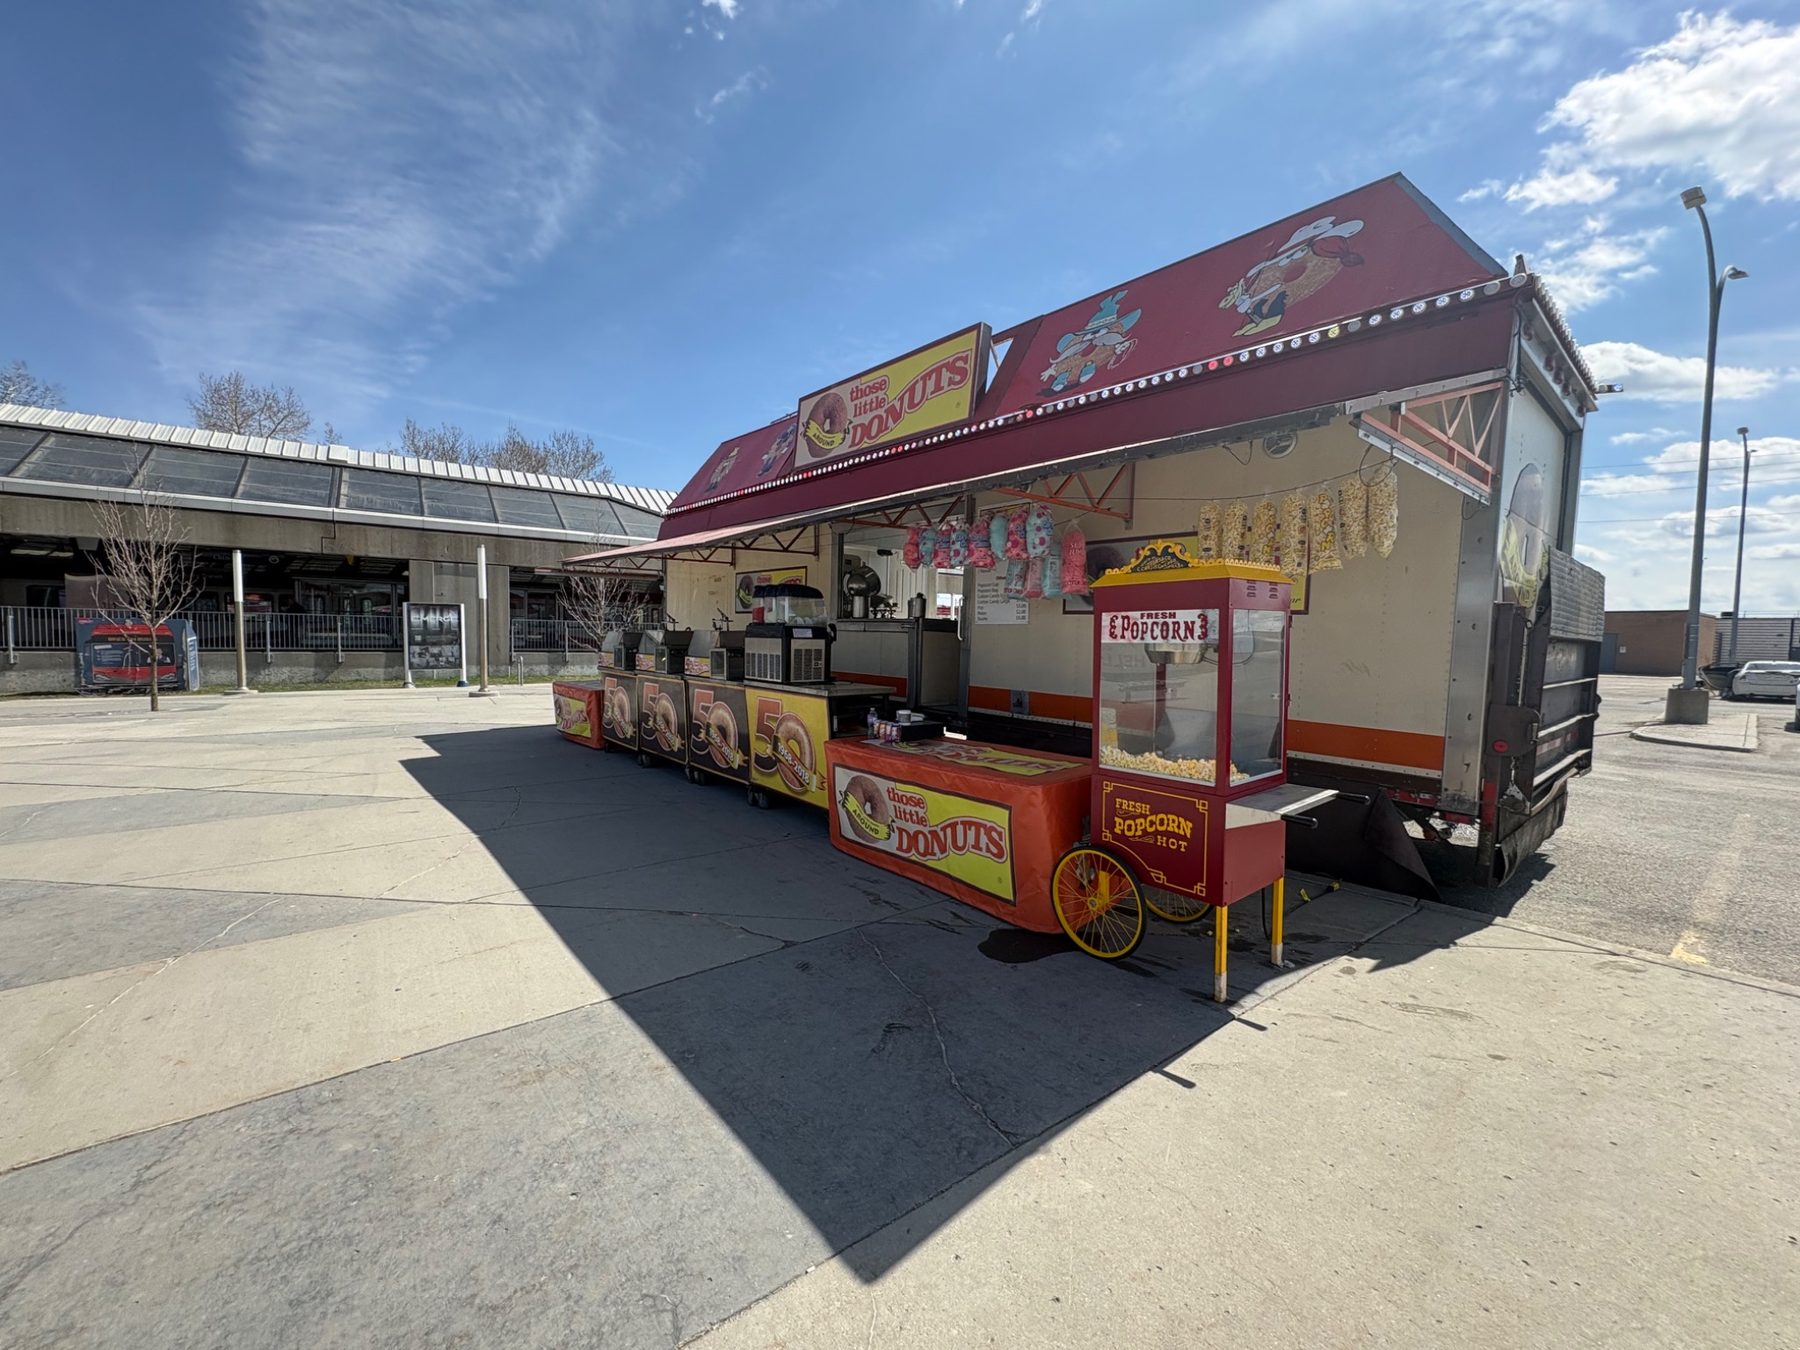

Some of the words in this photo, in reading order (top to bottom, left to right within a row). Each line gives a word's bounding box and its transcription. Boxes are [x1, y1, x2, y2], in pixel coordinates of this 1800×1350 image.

[848, 353, 969, 448] DONUTS
[849, 377, 888, 401] those
[852, 396, 887, 418] little
[812, 431, 835, 447] AROUND
[1139, 611, 1176, 620] FRESH
[1120, 615, 1196, 642] POPCORN
[753, 696, 816, 791] 50
[886, 786, 925, 810] those
[1115, 798, 1151, 815] FRESH
[852, 808, 880, 835] AROUND
[893, 805, 928, 827] little
[1114, 813, 1193, 839] POPCORN
[895, 819, 1005, 860] DONUTS
[1156, 835, 1188, 852] HOT
